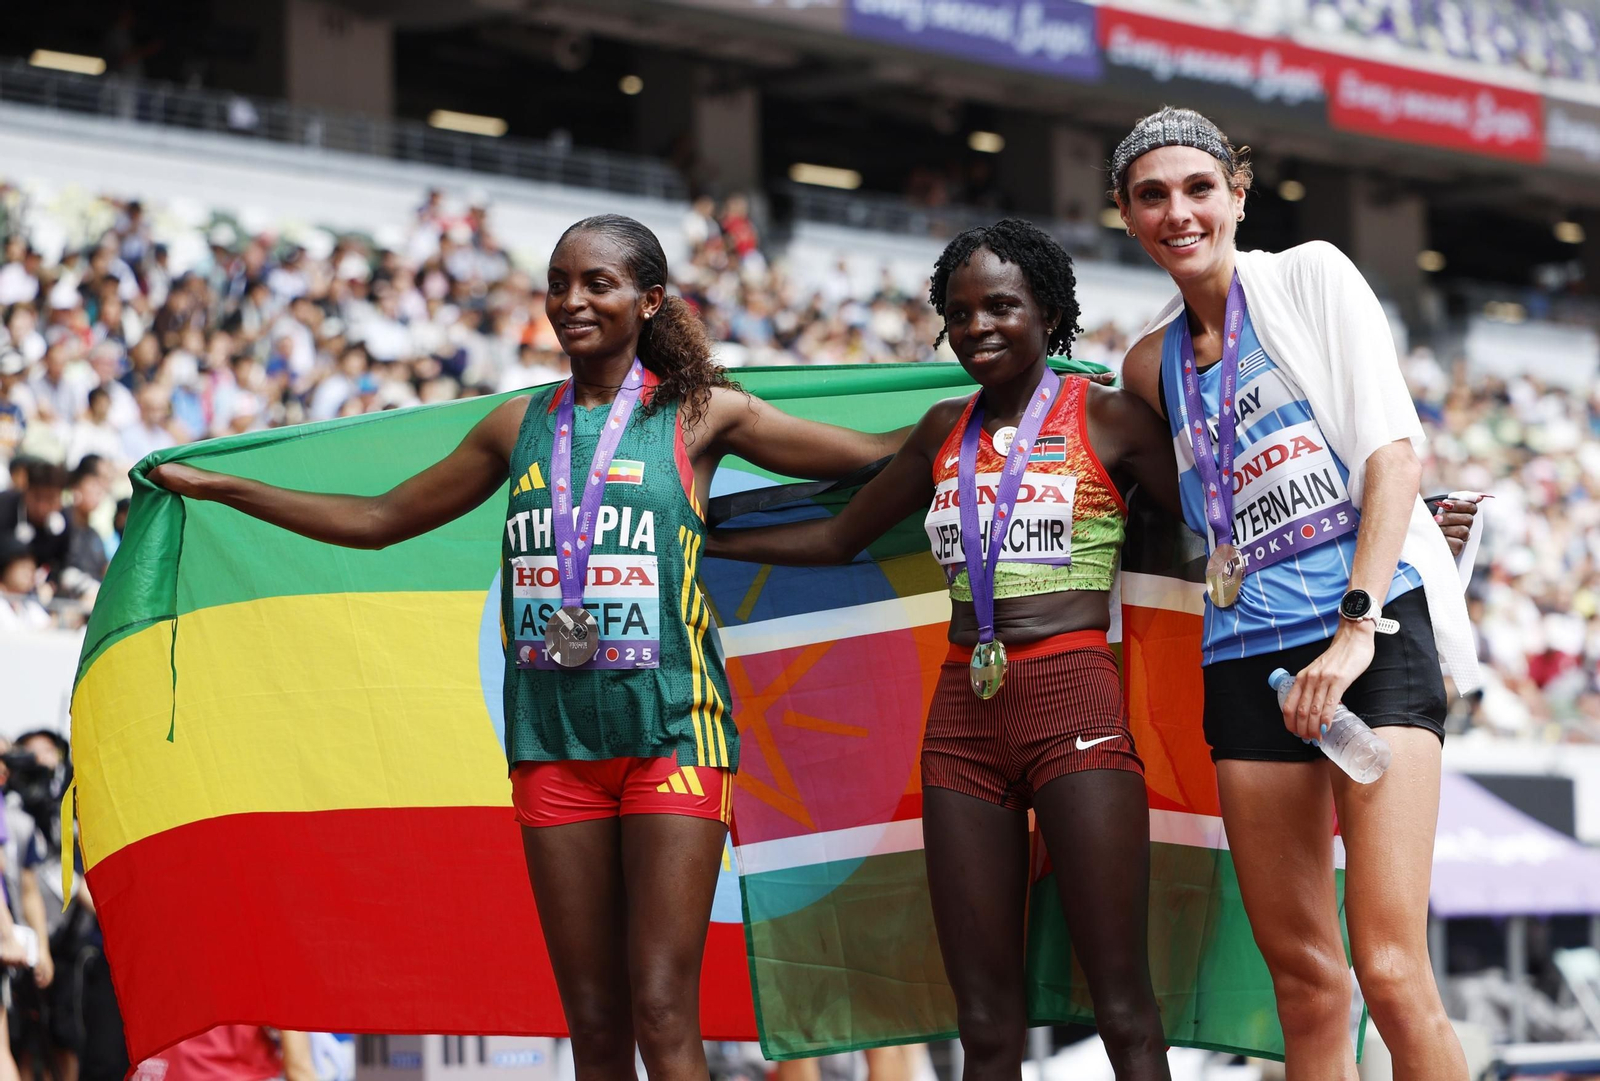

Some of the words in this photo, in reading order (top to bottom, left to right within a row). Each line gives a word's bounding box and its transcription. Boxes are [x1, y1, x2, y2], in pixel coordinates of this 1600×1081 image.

[1232, 435, 1323, 496] ONDA
[1231, 468, 1339, 546] ATERNAIN
[516, 566, 655, 587] HODA
[520, 602, 649, 636] ASFA
